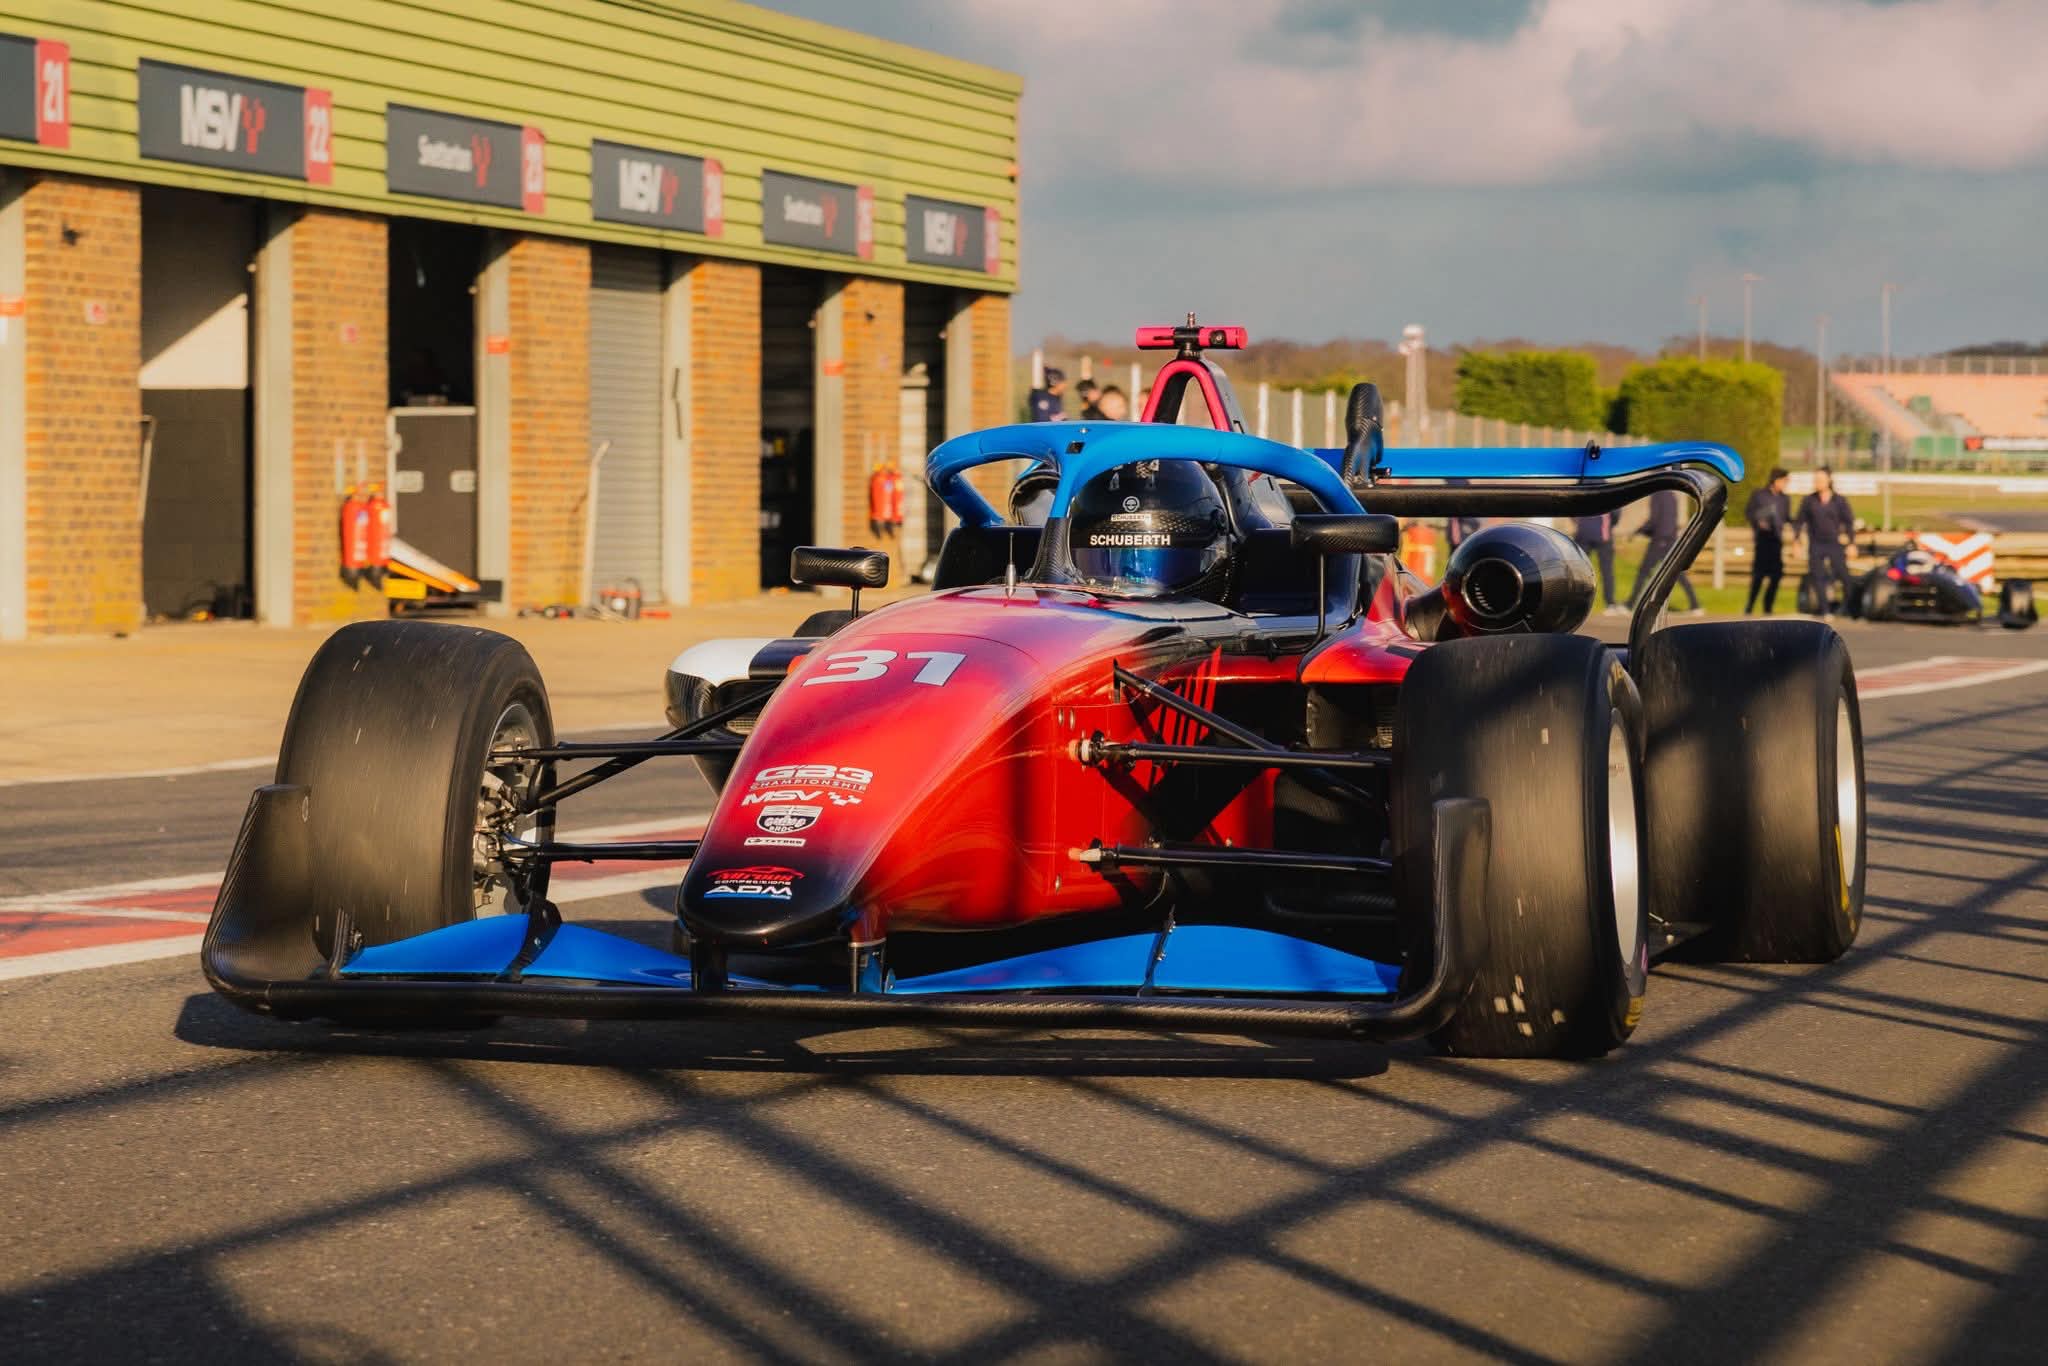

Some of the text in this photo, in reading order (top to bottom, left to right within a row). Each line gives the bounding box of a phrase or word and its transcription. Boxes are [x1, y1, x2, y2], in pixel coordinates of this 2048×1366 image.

[43, 60, 64, 123] 21
[180, 84, 241, 152] MSV
[1090, 534, 1171, 546] SCHUBERTH
[803, 649, 967, 687] 31
[755, 764, 873, 784] GB3
[750, 779, 867, 792] CHAMPIONSHIP
[741, 789, 824, 806] MSV
[705, 885, 793, 896] ADM
